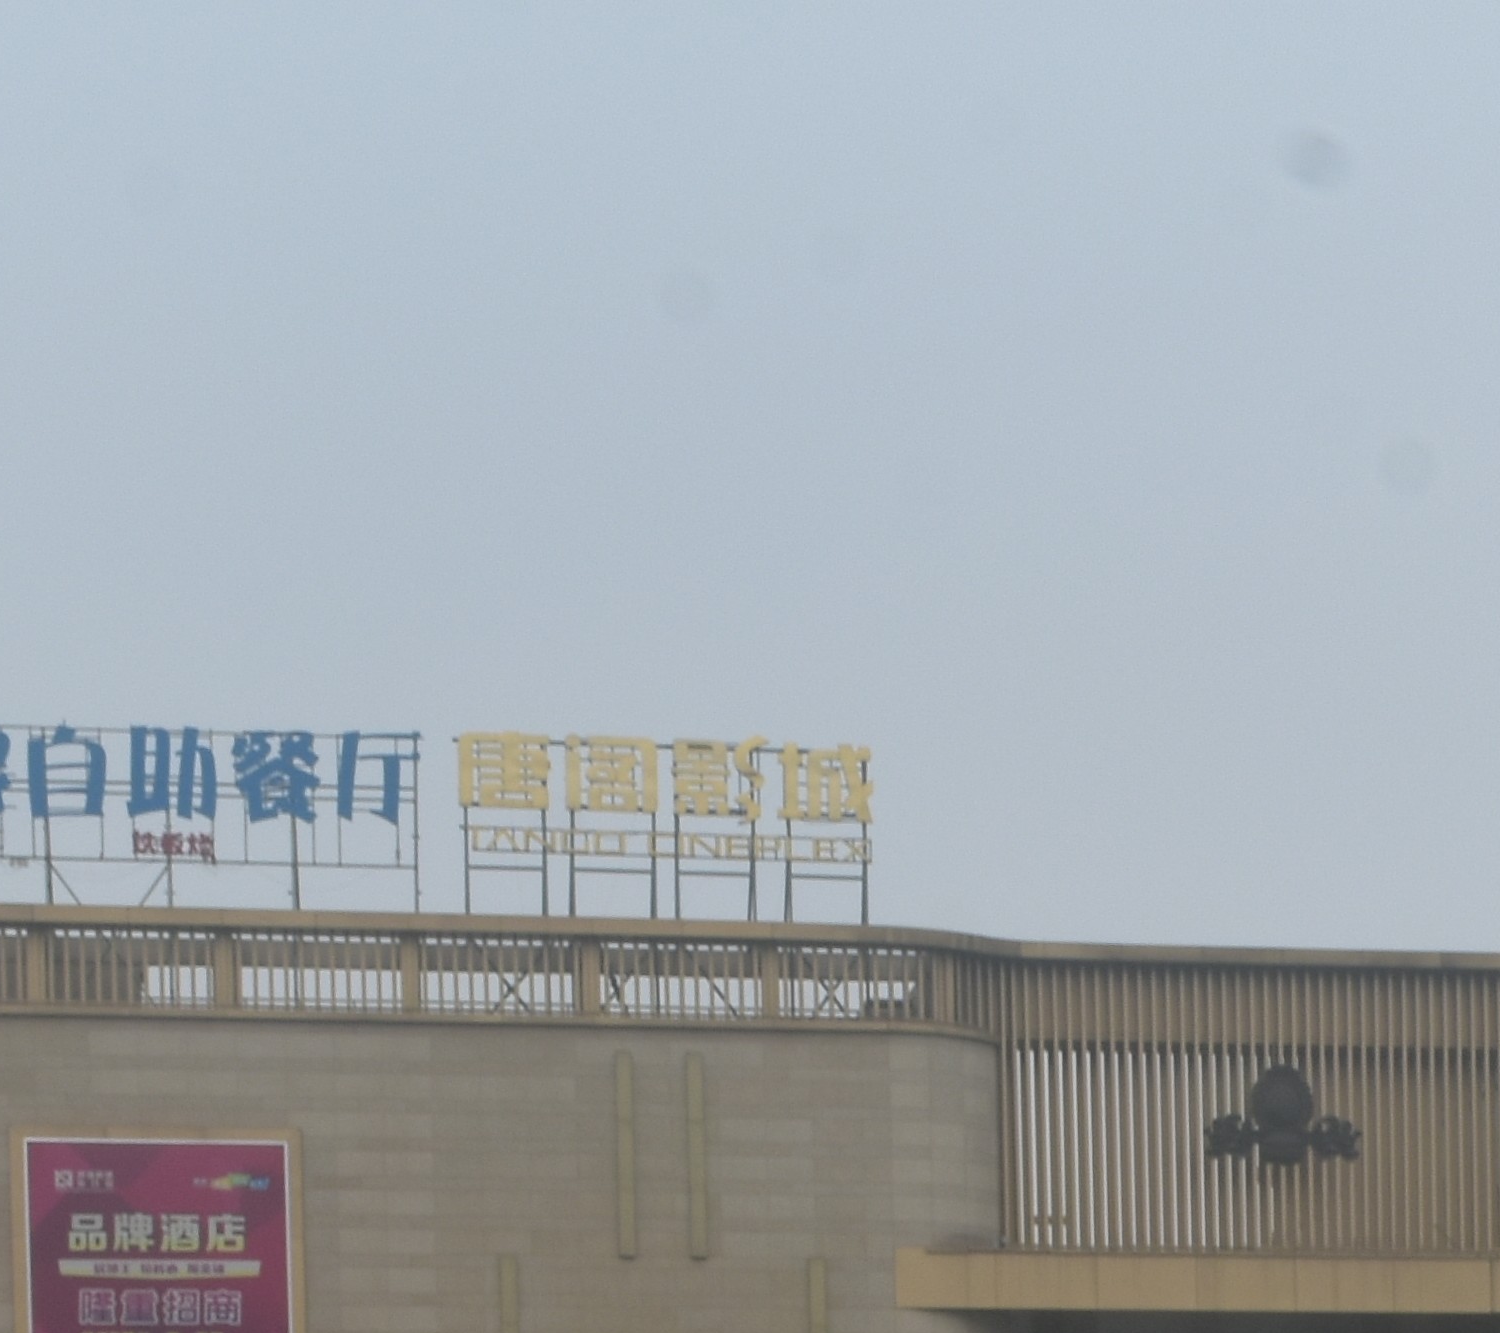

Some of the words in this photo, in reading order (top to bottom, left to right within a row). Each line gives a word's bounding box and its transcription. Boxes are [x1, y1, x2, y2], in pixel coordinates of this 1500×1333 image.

[647, 831, 872, 864] CINEPLEX
[68, 1212, 247, 1253] 品牌酒店
[78, 1287, 243, 1326] 隆重招商
